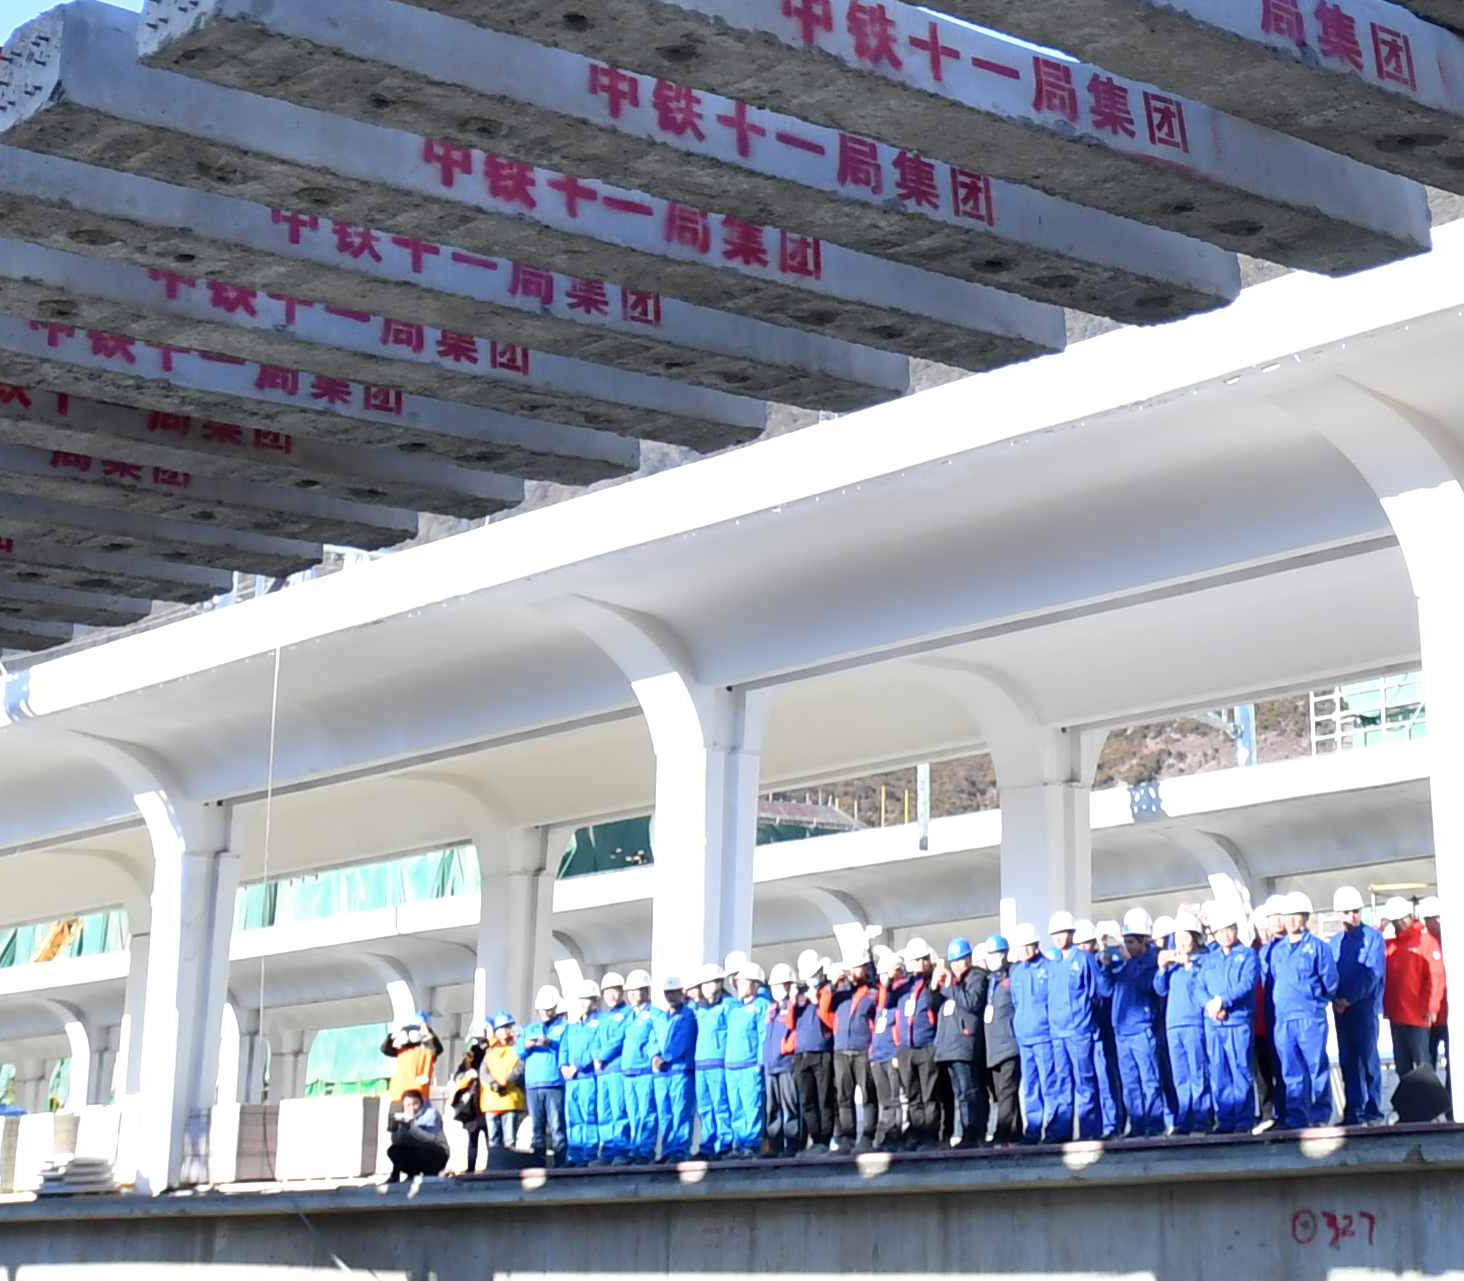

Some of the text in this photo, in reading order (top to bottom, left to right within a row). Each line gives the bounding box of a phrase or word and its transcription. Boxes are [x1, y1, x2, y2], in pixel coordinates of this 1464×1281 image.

[423, 140, 822, 279] 中铁十一局集团
[589, 63, 994, 226] 中铁十一局集团
